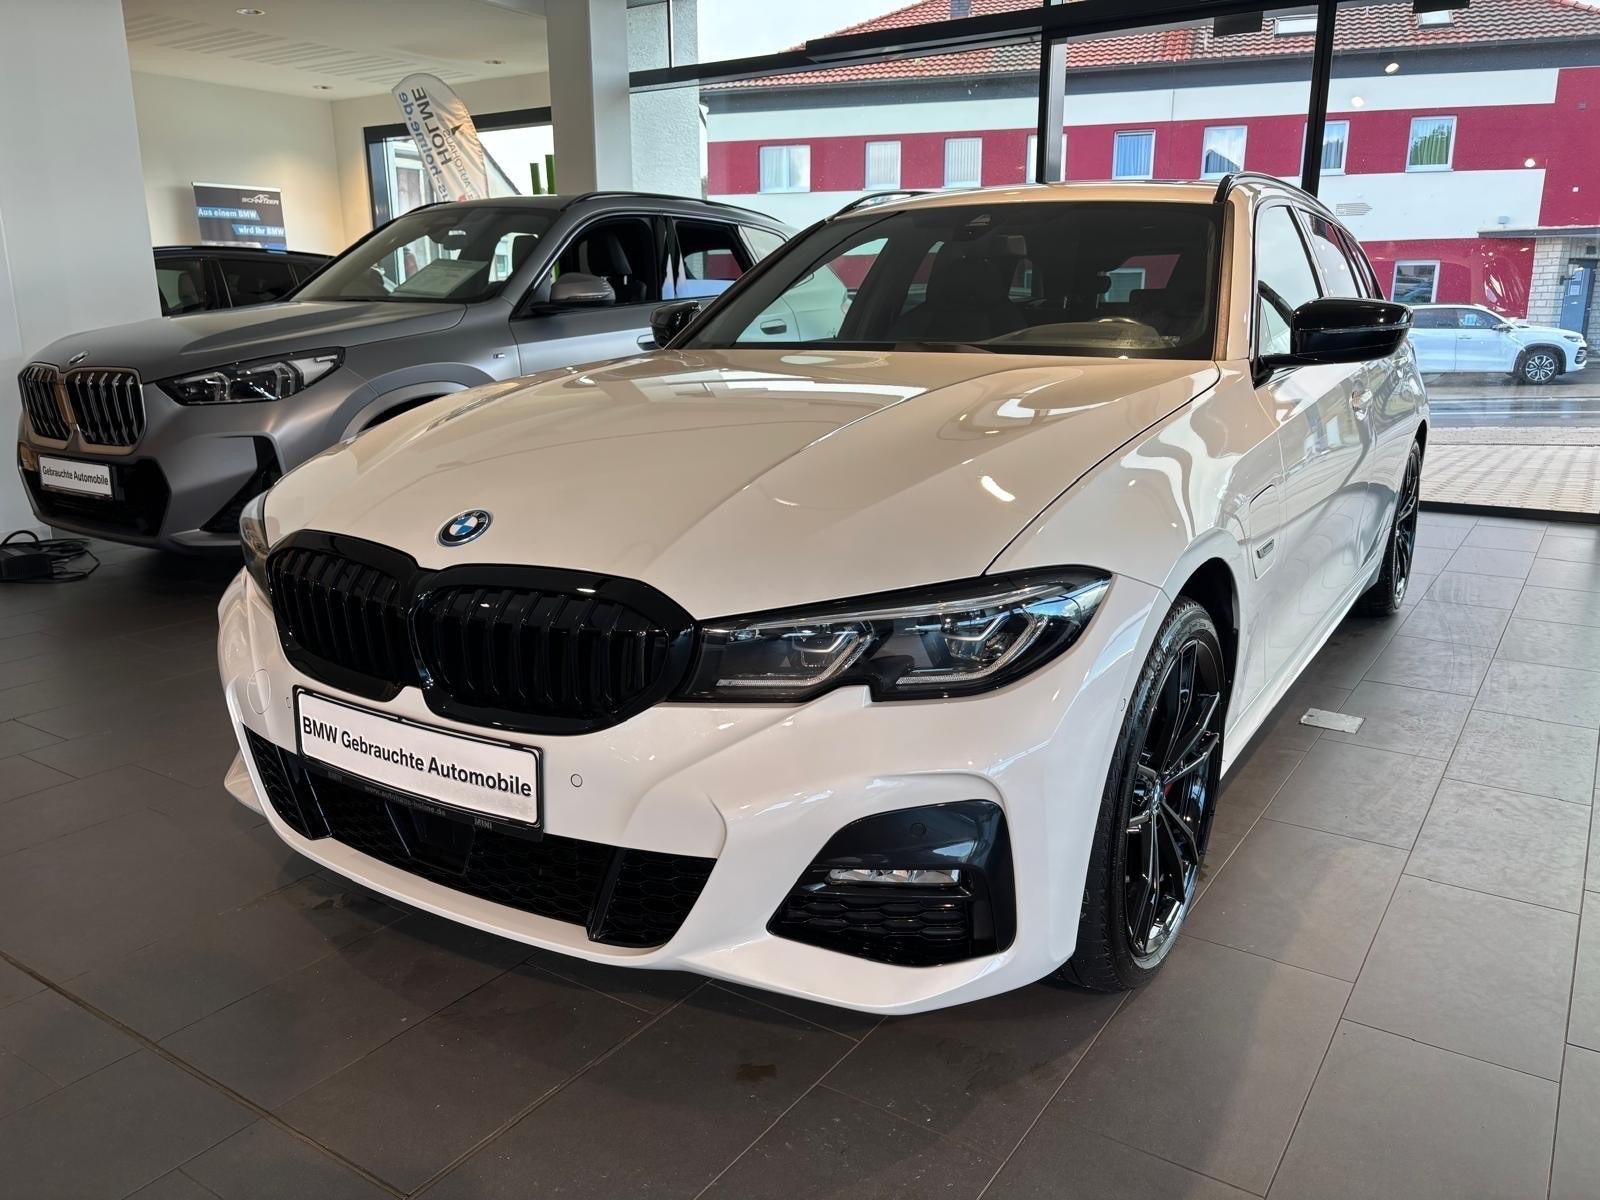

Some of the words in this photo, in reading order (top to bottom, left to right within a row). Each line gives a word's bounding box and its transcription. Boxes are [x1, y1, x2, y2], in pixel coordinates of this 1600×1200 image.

[198, 208, 213, 217] Aus
[213, 209, 237, 218] einem
[238, 210, 257, 219] BMW
[238, 225, 254, 234] wird
[266, 226, 285, 236] BMW
[42, 465, 73, 480] Gebrauchte
[73, 470, 109, 486] Automobile
[302, 715, 338, 745] BMW
[340, 730, 425, 772] Gebrauchte
[427, 756, 532, 798] Automobile
[474, 817, 493, 831] MINI
